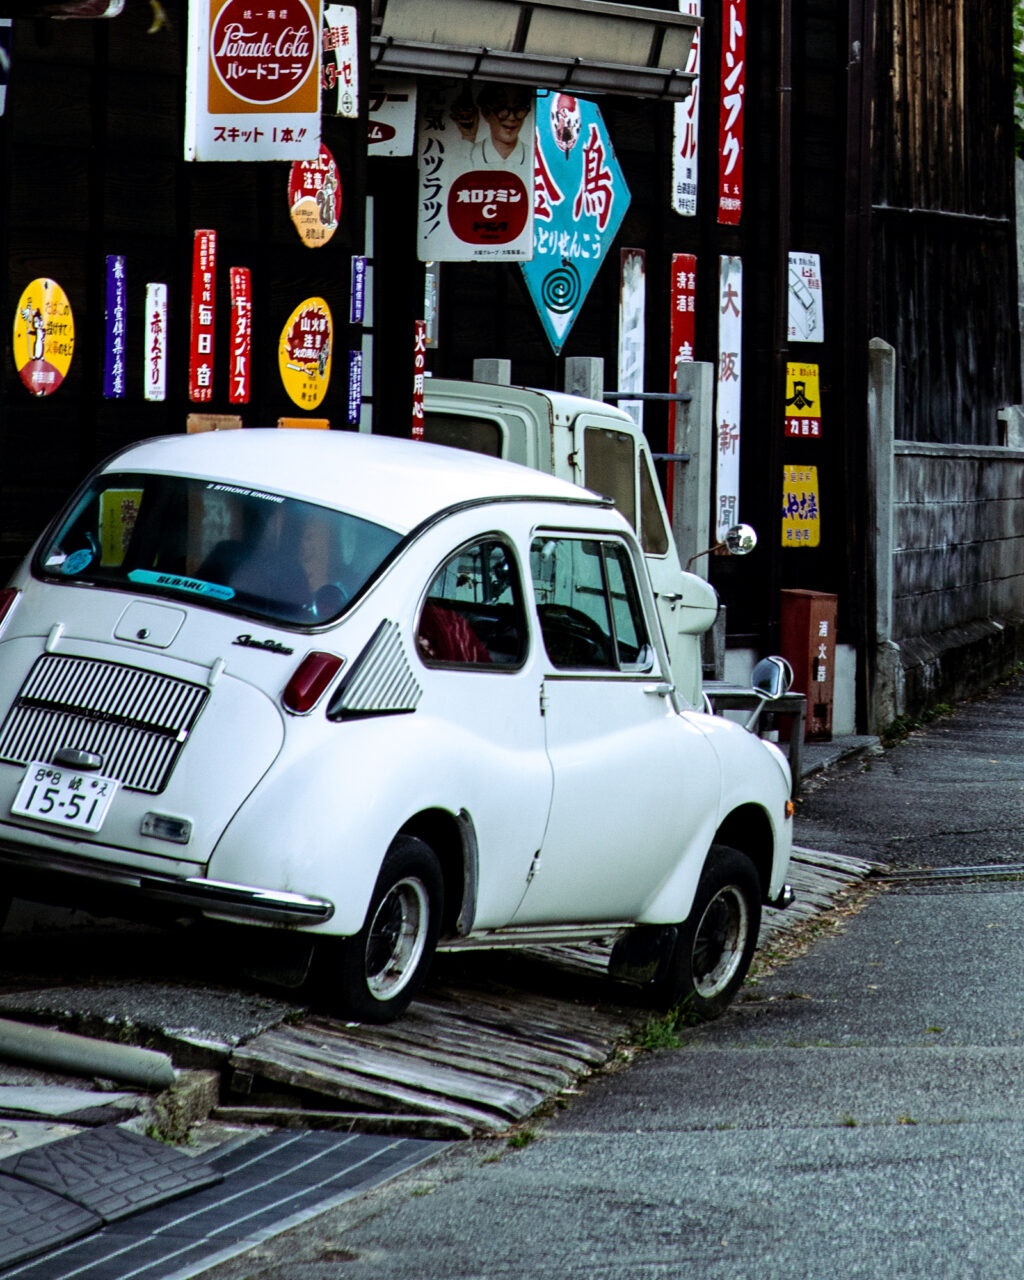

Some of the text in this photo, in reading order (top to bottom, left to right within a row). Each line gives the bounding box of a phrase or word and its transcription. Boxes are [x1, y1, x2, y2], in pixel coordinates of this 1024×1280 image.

[226, 61, 303, 80] パレードコーラ
[721, 3, 746, 176] トンプク
[213, 126, 264, 143] スキット
[303, 171, 323, 189] 注意
[457, 188, 522, 204] オロナミン
[482, 204, 497, 219] C
[196, 304, 213, 386] 毎日香
[413, 327, 426, 418] 火の用心
[718, 283, 741, 527] 大阪新聞
[157, 575, 205, 592] SUBARU
[818, 620, 828, 682] 消火器
[25, 784, 99, 824] 15-51
